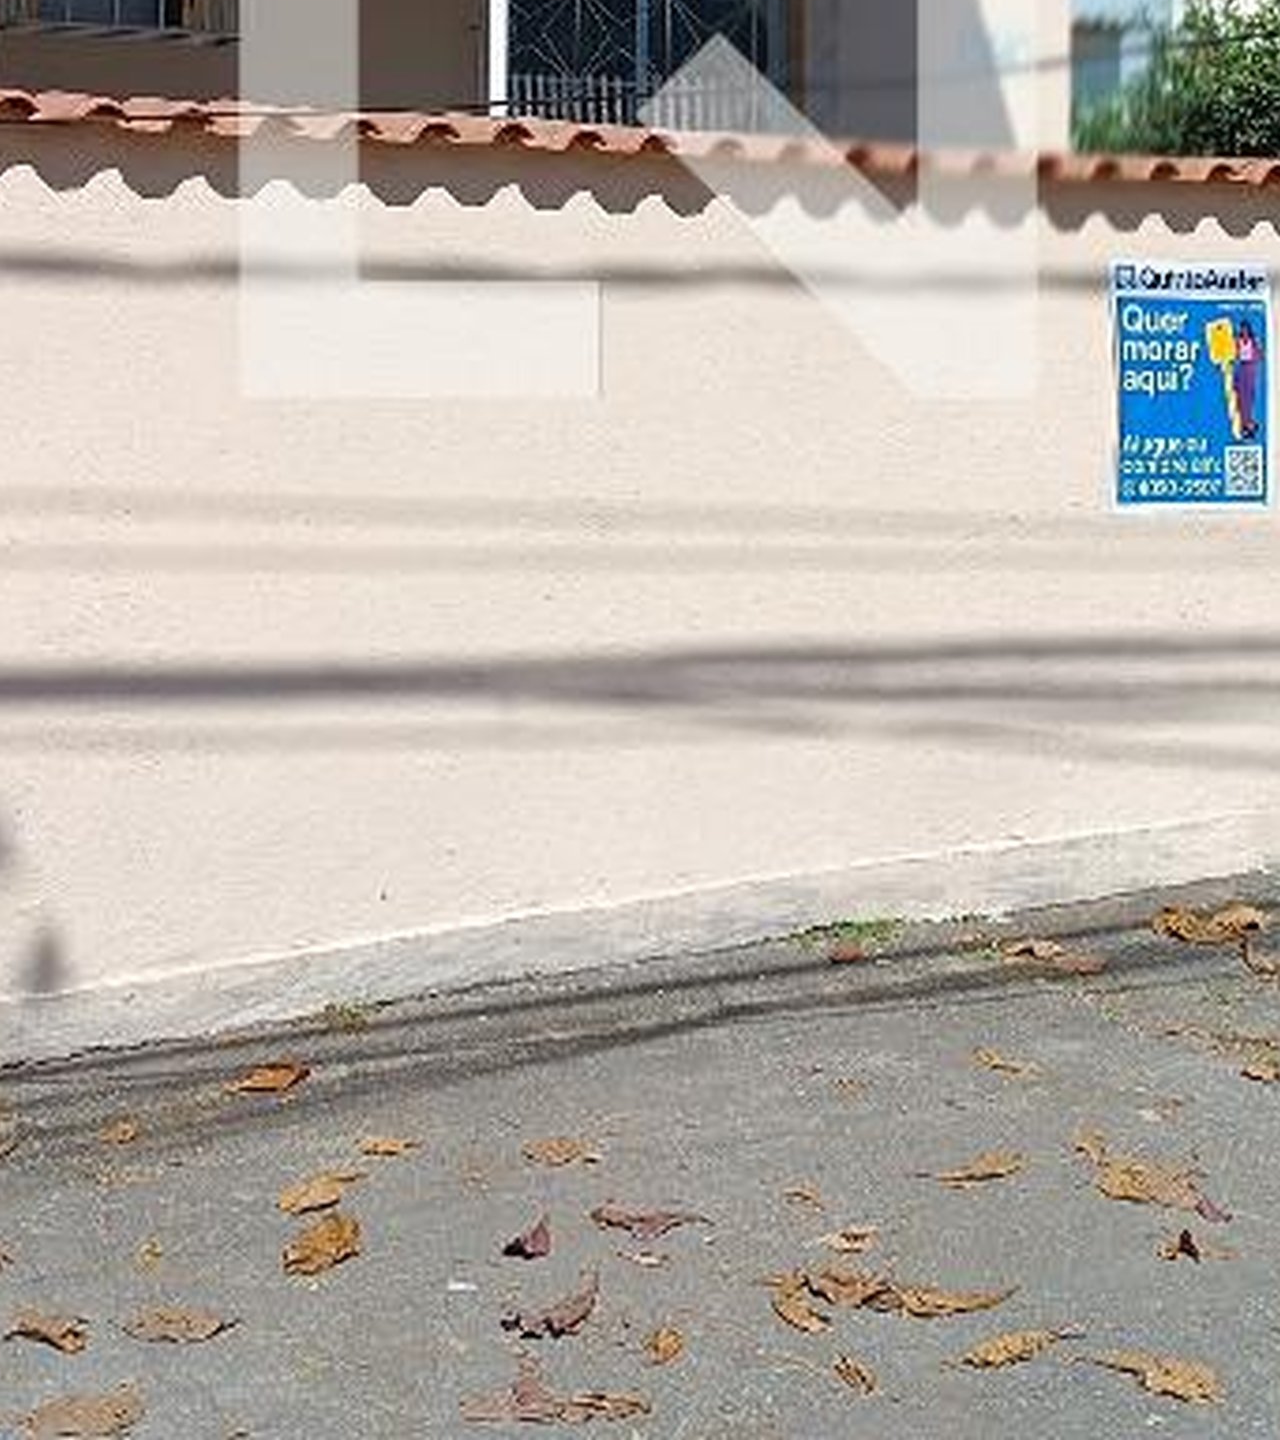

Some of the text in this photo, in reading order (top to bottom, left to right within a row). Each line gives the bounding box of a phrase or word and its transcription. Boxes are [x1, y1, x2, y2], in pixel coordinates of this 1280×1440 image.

[1122, 304, 1189, 332] Quer
[1122, 339, 1200, 361] morar
[1122, 363, 1194, 398] aqui?
